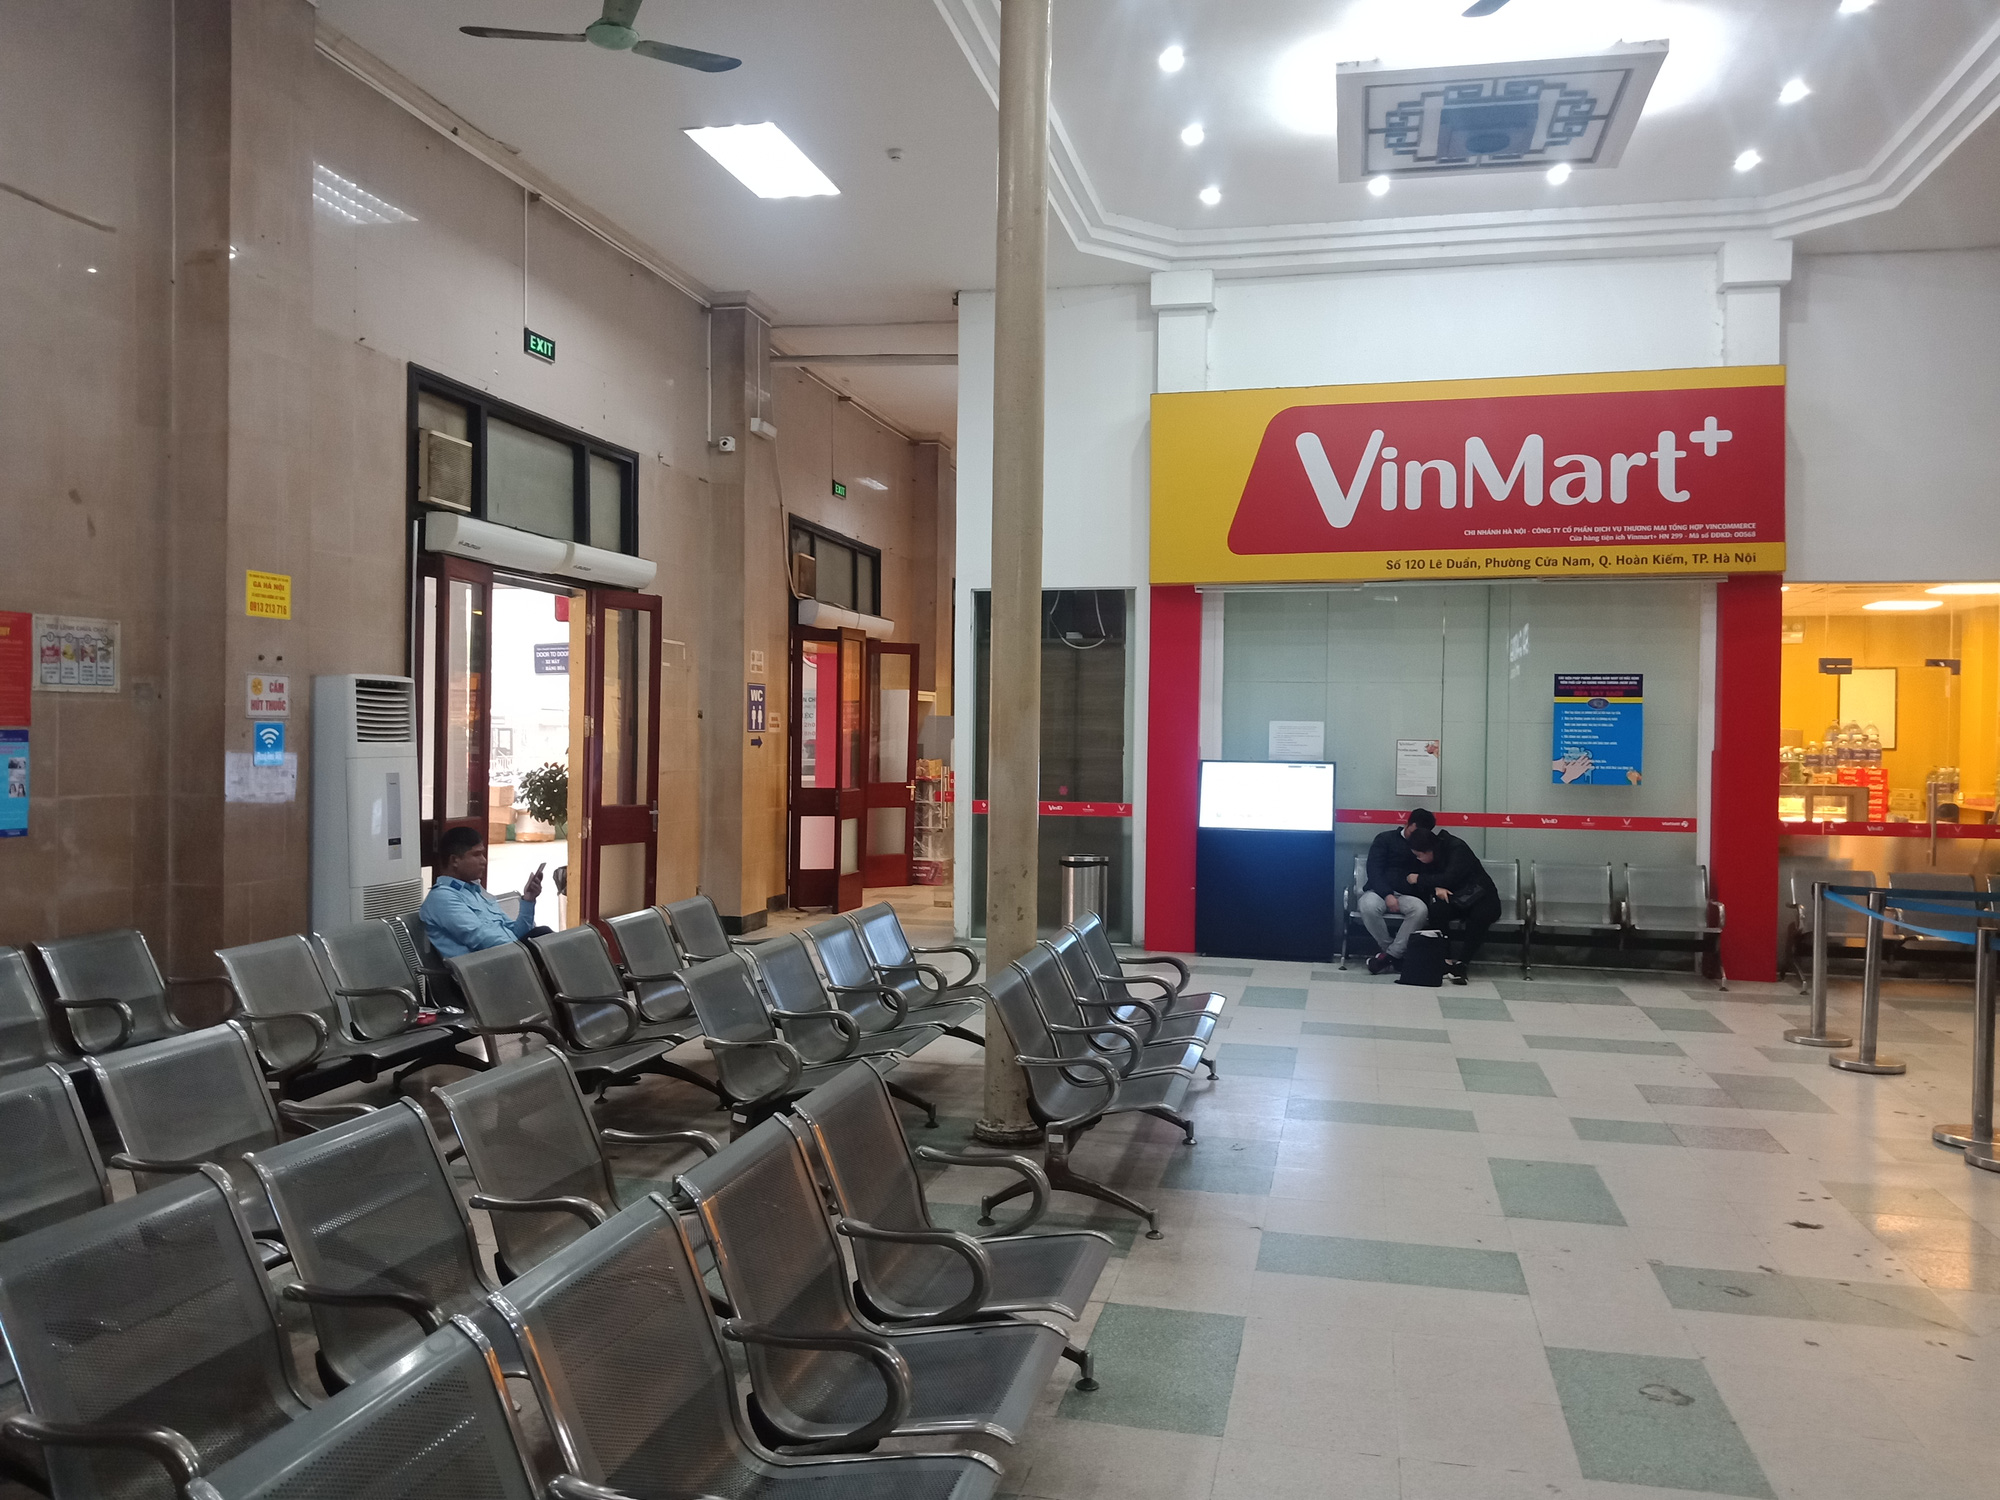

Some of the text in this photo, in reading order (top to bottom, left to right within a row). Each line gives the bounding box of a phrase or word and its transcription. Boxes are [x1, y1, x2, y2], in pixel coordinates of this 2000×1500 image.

[530, 335, 553, 357] EXIT
[835, 484, 846, 496] EXIT
[1477, 527, 1501, 536] NHÁNH
[1502, 527, 1513, 535] HÀ
[1514, 527, 1526, 536] NỘI
[1532, 526, 1551, 535] CÔNG
[1594, 525, 1611, 534] DỊCH
[1612, 525, 1622, 534] VỤ
[1653, 524, 1667, 533] MẠI
[1705, 522, 1757, 531] VINCOMMERCE
[1583, 534, 1600, 543] hàng
[1386, 552, 1757, 570] Số 120 Lê Duẩn, Phường Cửa Nam, Q. Hoàn Kiếm, TP. Hà Nội
[269, 679, 284, 693] CẤM
[750, 689, 763, 702] WC
